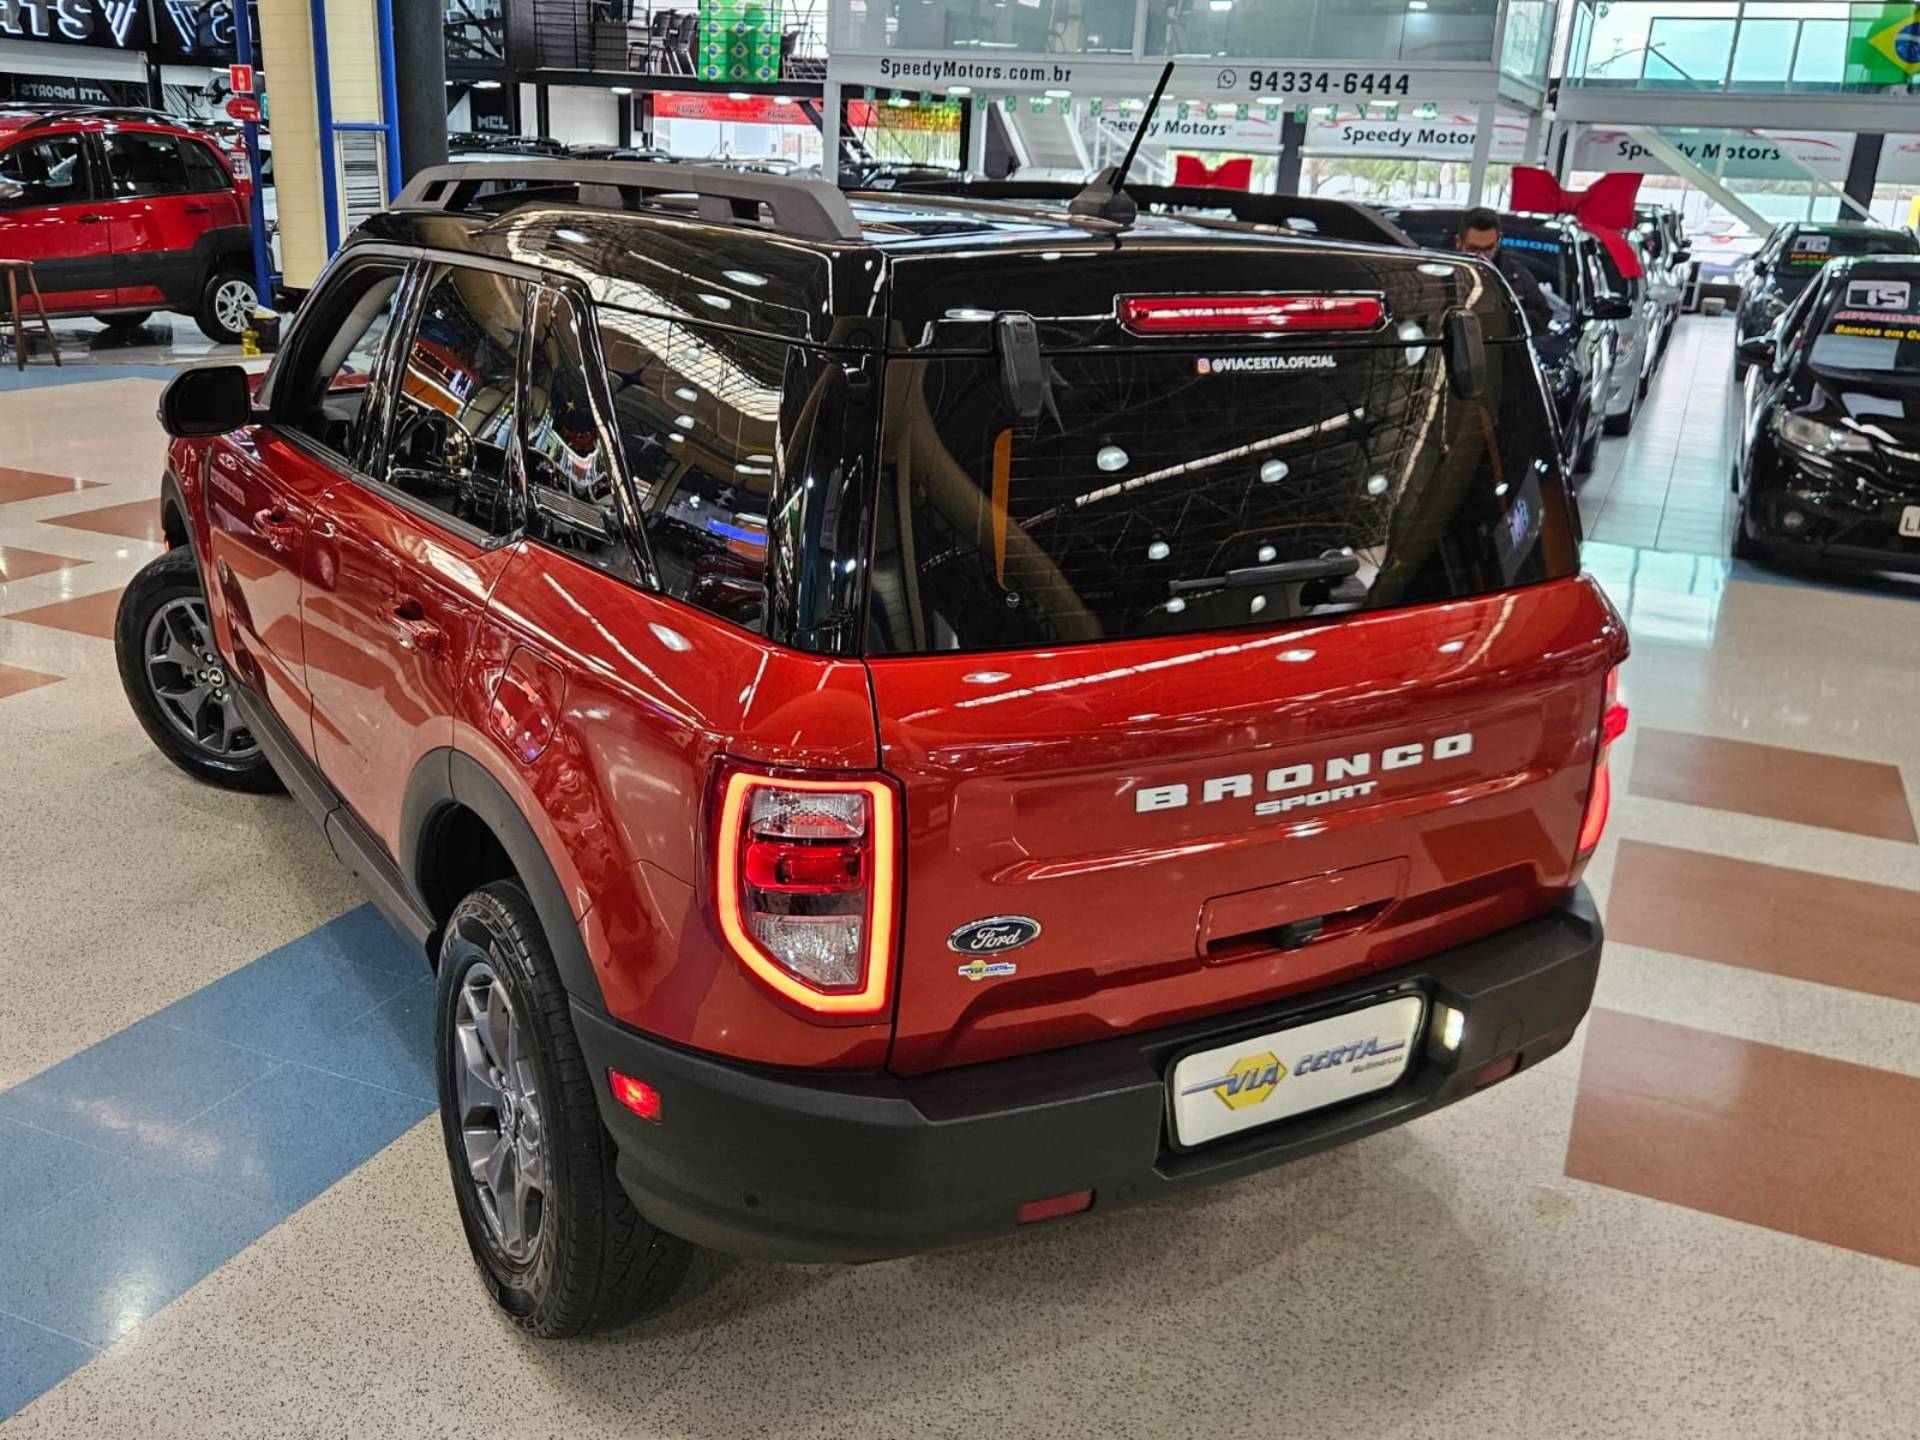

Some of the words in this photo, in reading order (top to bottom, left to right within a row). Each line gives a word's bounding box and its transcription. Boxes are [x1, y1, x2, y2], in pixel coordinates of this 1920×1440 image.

[880, 58, 1072, 82] SpeedyMotors.com.br
[1249, 70, 1410, 96] 94334-6444
[1164, 119, 1227, 136] Motors
[1341, 126, 1412, 147] Speedy
[1701, 143, 1781, 160] Motors
[1211, 354, 1337, 373] @VIACERTA.OFICIAL
[1135, 732, 1473, 813] BRONCO
[1254, 780, 1378, 816] SPORT
[970, 925, 1022, 950] Ford
[1226, 1062, 1280, 1096] VIA
[1293, 1036, 1379, 1077] CERTA
